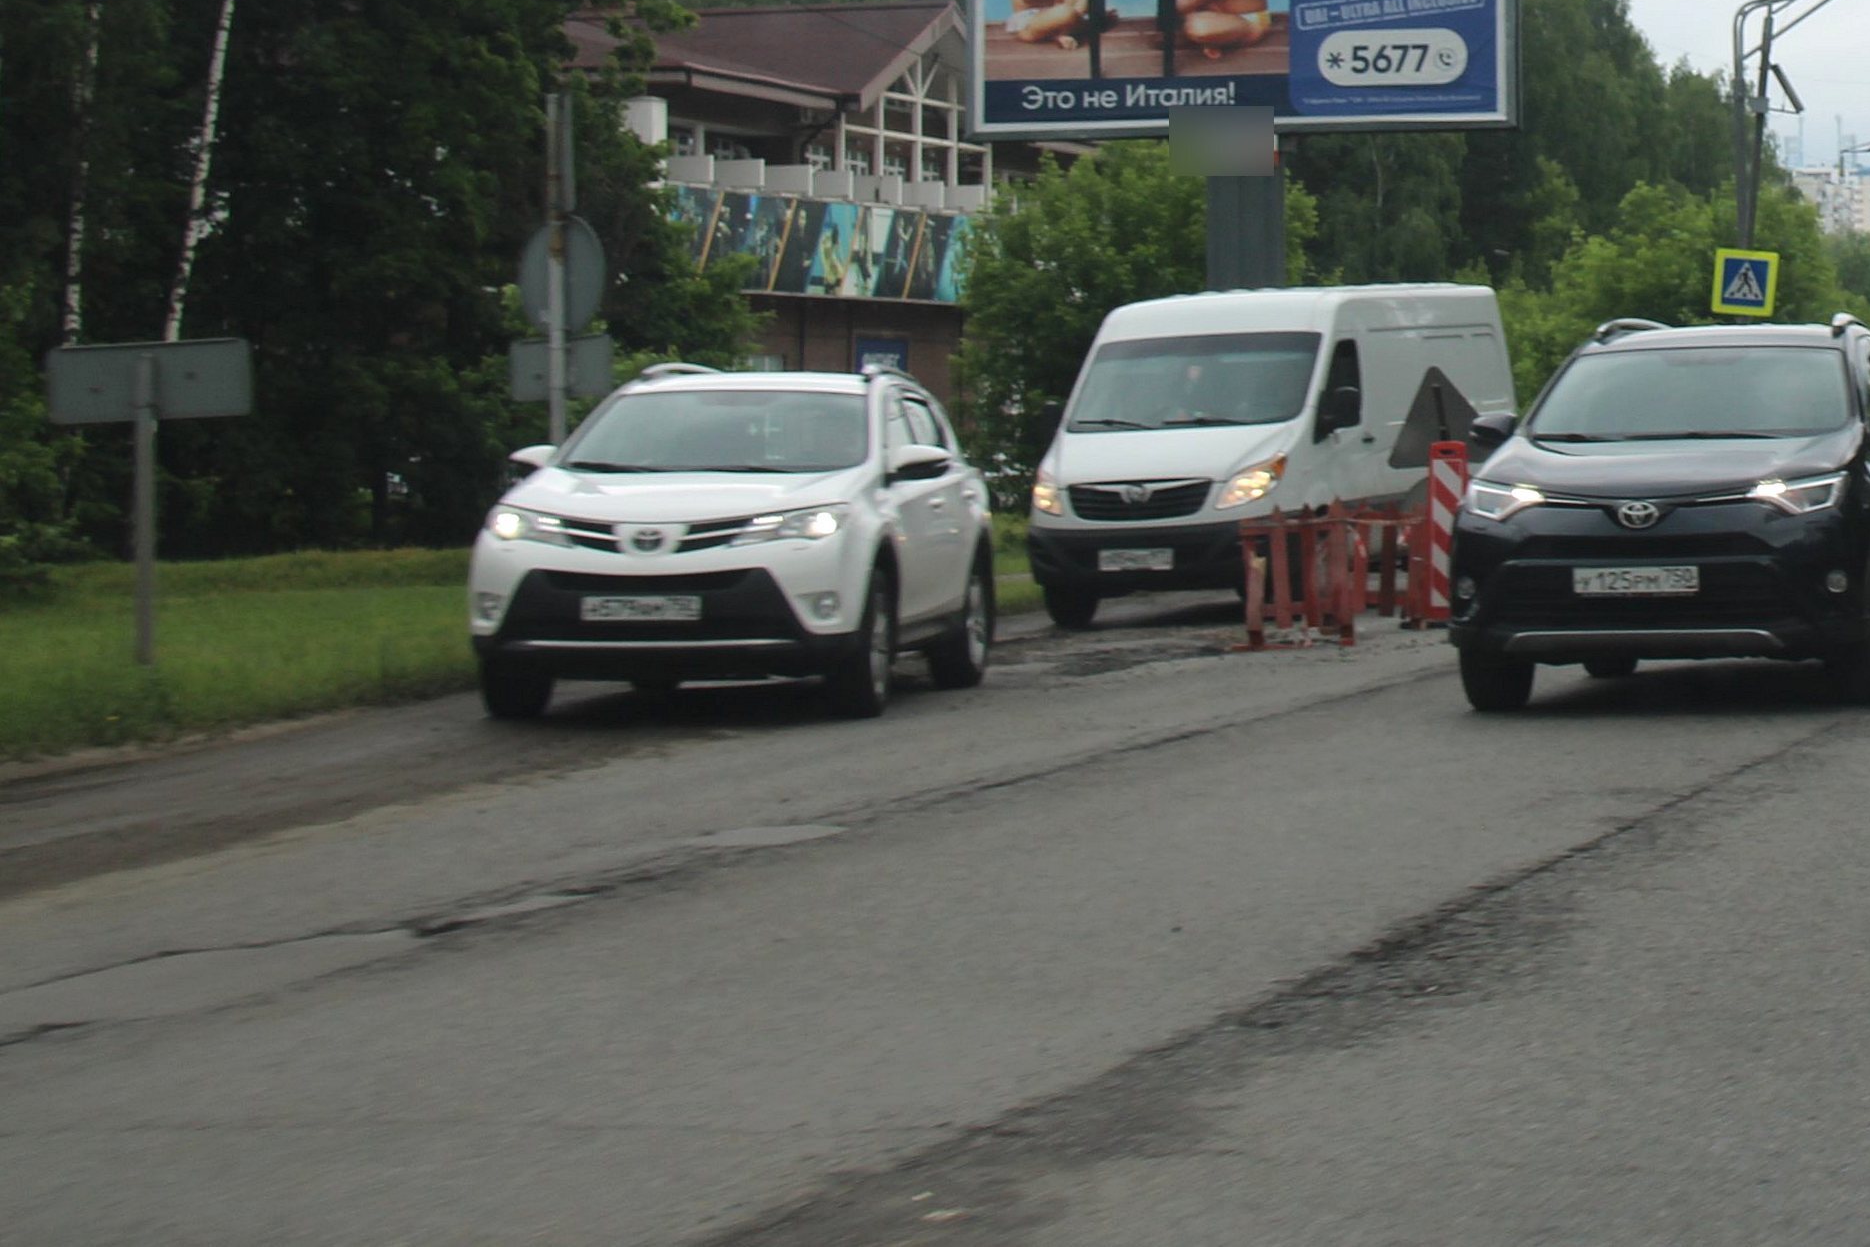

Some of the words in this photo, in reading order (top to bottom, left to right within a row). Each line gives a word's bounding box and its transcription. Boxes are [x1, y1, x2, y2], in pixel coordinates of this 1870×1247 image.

[1022, 85, 1075, 110] Это
[1082, 90, 1118, 109] не
[1125, 81, 1236, 108] Италия!
